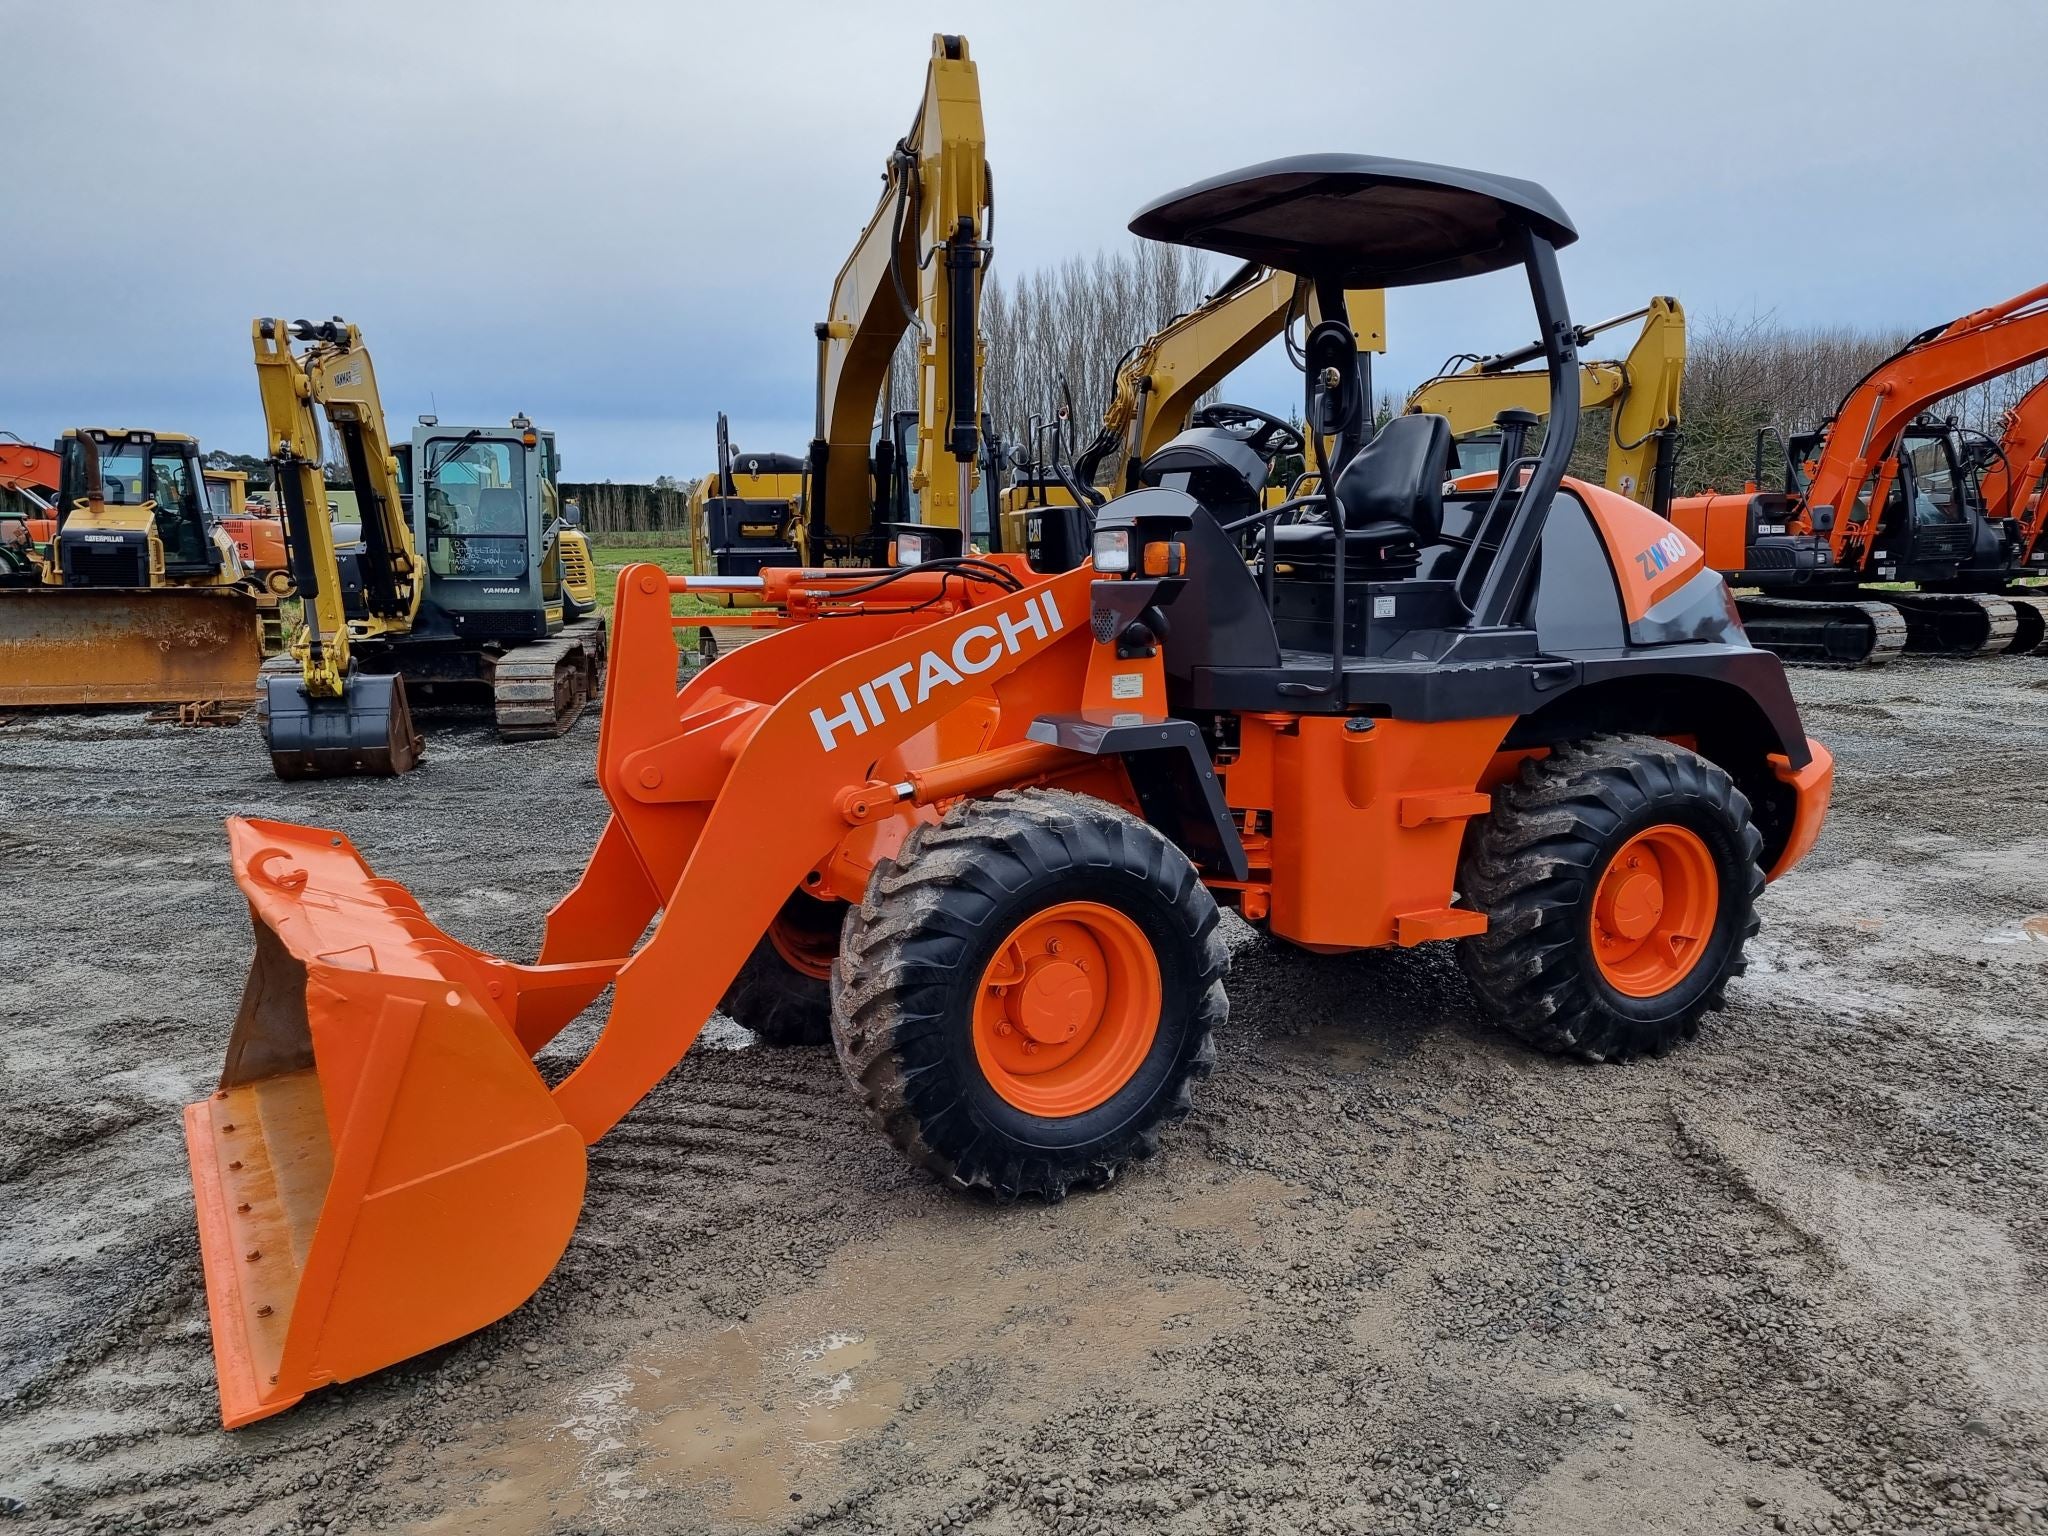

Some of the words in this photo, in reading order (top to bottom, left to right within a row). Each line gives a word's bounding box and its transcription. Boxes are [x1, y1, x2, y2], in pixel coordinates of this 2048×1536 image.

[84, 535, 124, 543] CATERPILLAR
[1028, 518, 1042, 542] CAT
[1635, 532, 1686, 581] ZW80
[809, 589, 1064, 752] HITACHI
